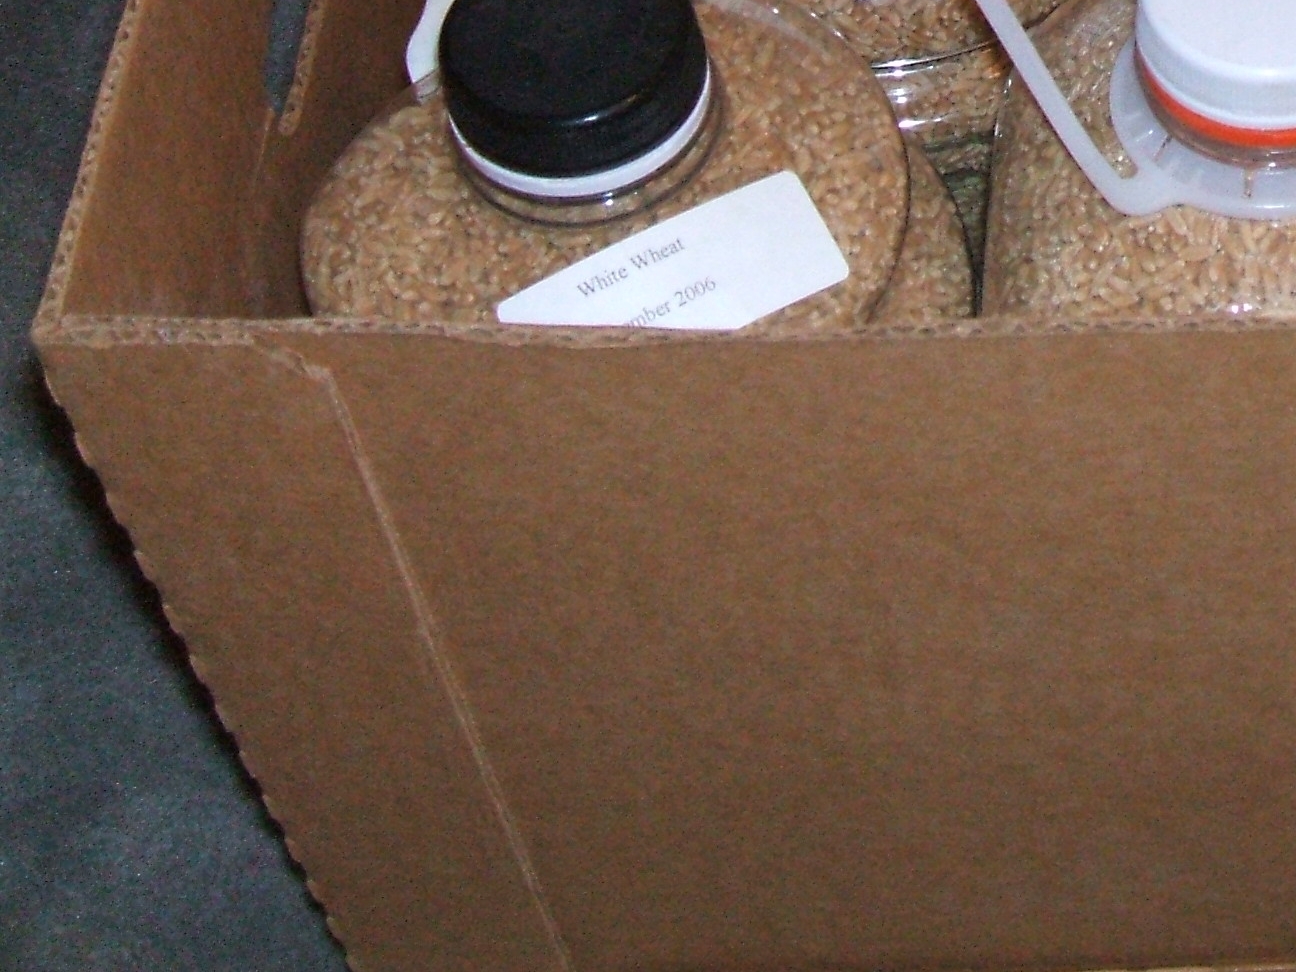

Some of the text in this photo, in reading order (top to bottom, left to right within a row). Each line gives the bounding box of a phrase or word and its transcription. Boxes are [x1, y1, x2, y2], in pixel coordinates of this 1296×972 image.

[576, 237, 685, 296] White Wheat
[673, 275, 718, 308] 2006
